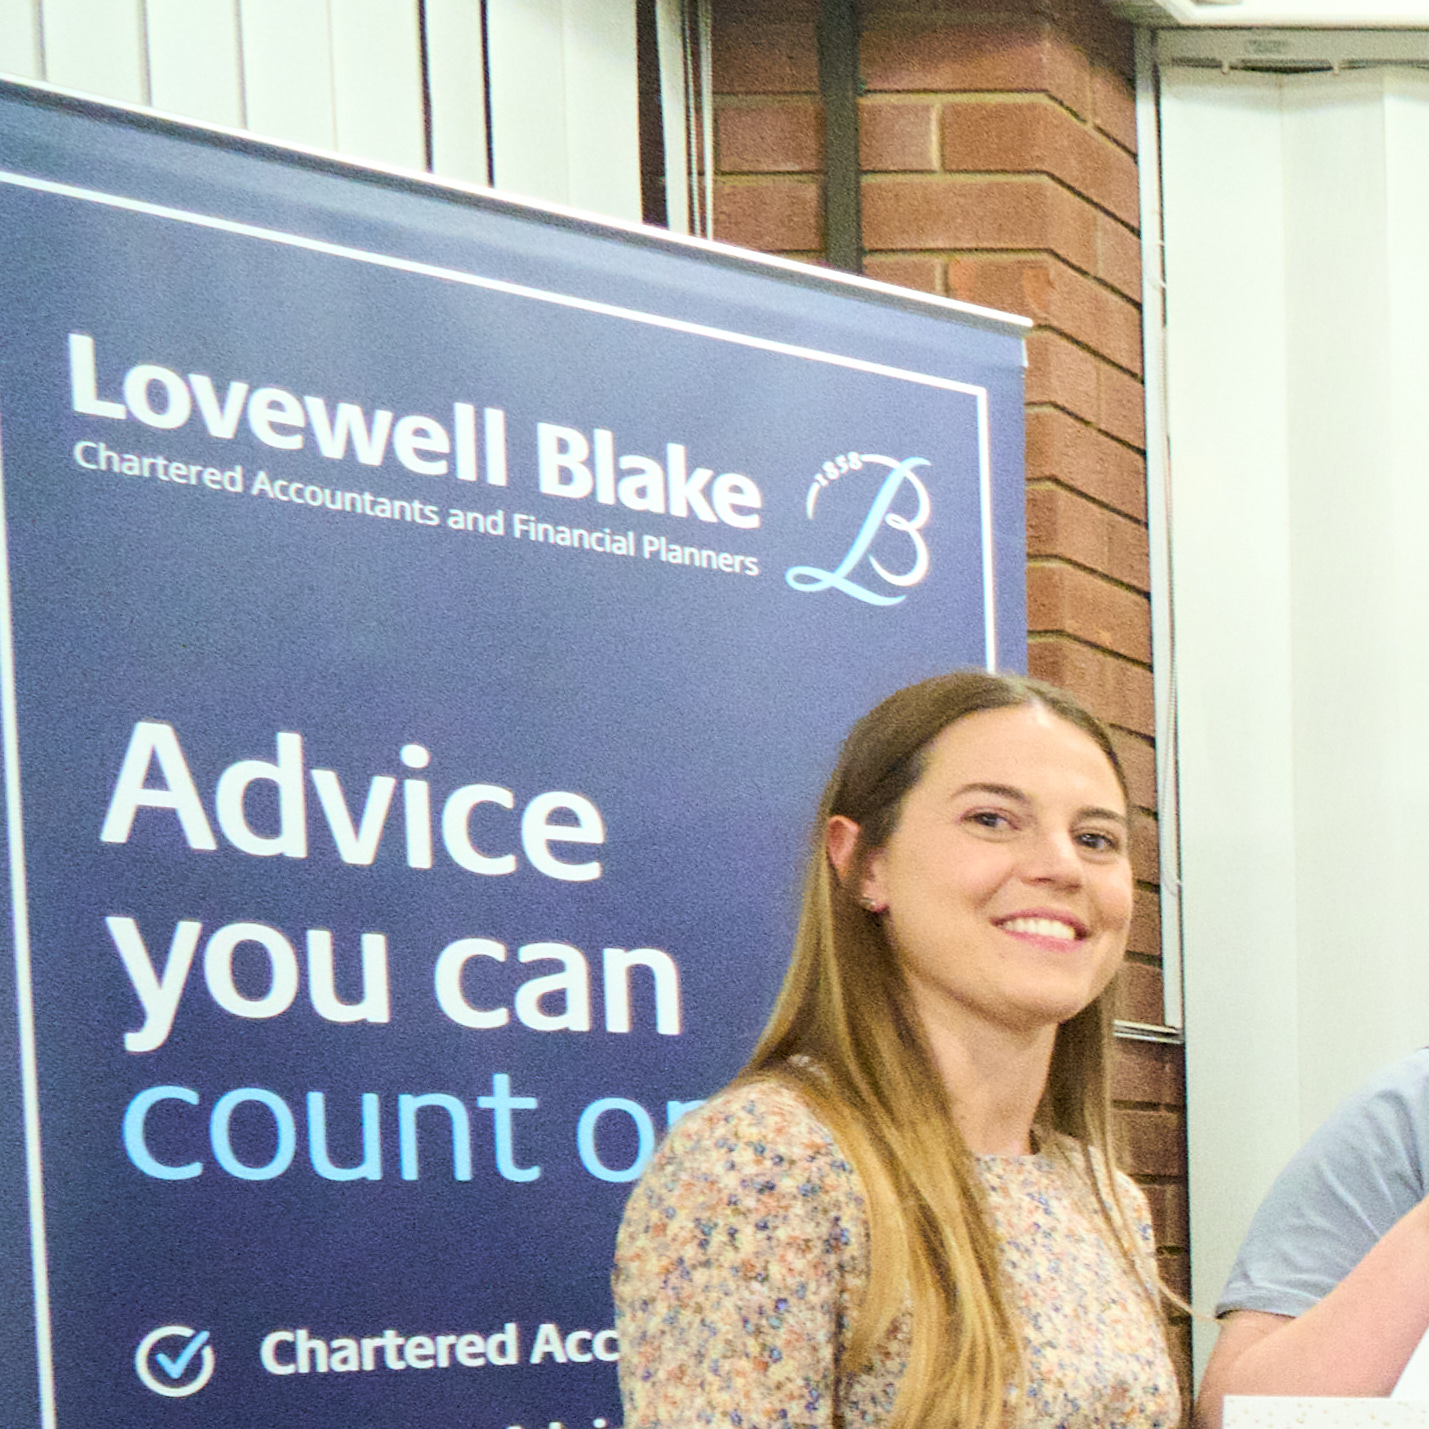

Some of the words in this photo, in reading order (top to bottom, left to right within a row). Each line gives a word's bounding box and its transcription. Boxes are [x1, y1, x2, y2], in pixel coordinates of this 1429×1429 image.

[68, 332, 506, 487] Lovewell
[537, 421, 763, 529] Blake
[814, 451, 863, 487] 1858
[73, 440, 243, 493] Chartered
[251, 470, 441, 527] Accountants
[448, 508, 505, 536] and
[512, 512, 635, 557] Financial
[642, 534, 760, 576] Planners
[100, 721, 605, 881] Advice
[105, 916, 391, 1053] you
[434, 938, 682, 1036] can
[122, 1073, 541, 1183] count
[576, 1096, 704, 1183] o
[260, 1322, 518, 1375] Chartered
